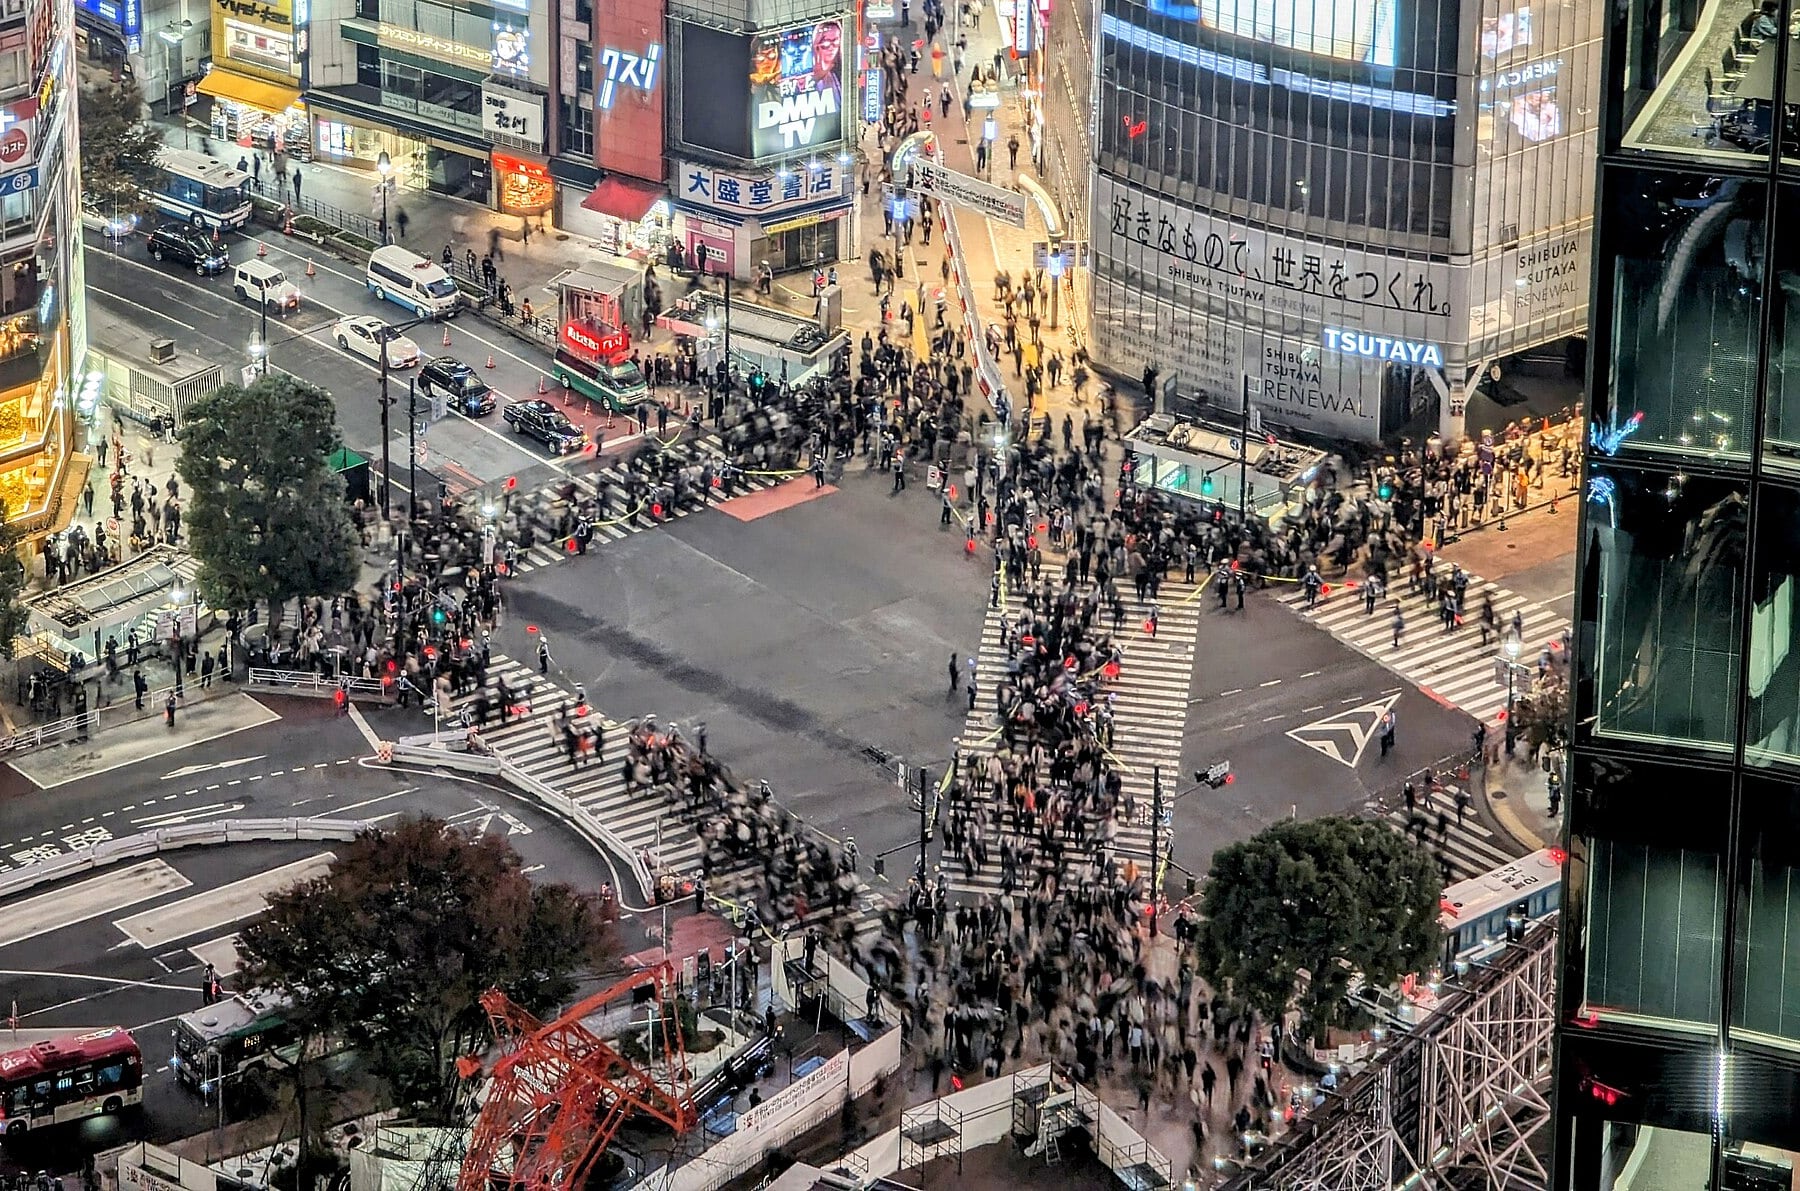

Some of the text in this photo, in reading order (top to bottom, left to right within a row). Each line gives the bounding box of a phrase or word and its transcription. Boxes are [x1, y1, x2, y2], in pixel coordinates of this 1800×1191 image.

[599, 44, 659, 109] クスリ
[758, 87, 836, 129] DMM
[779, 117, 816, 148] TV
[688, 167, 833, 205] 大盛堂書店
[1111, 194, 1452, 317] 好きなもので、世界をつくれ。
[1519, 241, 1578, 269] SHIBUYA
[1168, 265, 1213, 287] SHIBUYA
[1216, 280, 1265, 302] TSUTAYA
[1324, 327, 1441, 366] TSUTAYA
[1266, 362, 1321, 385] TSUTAYA
